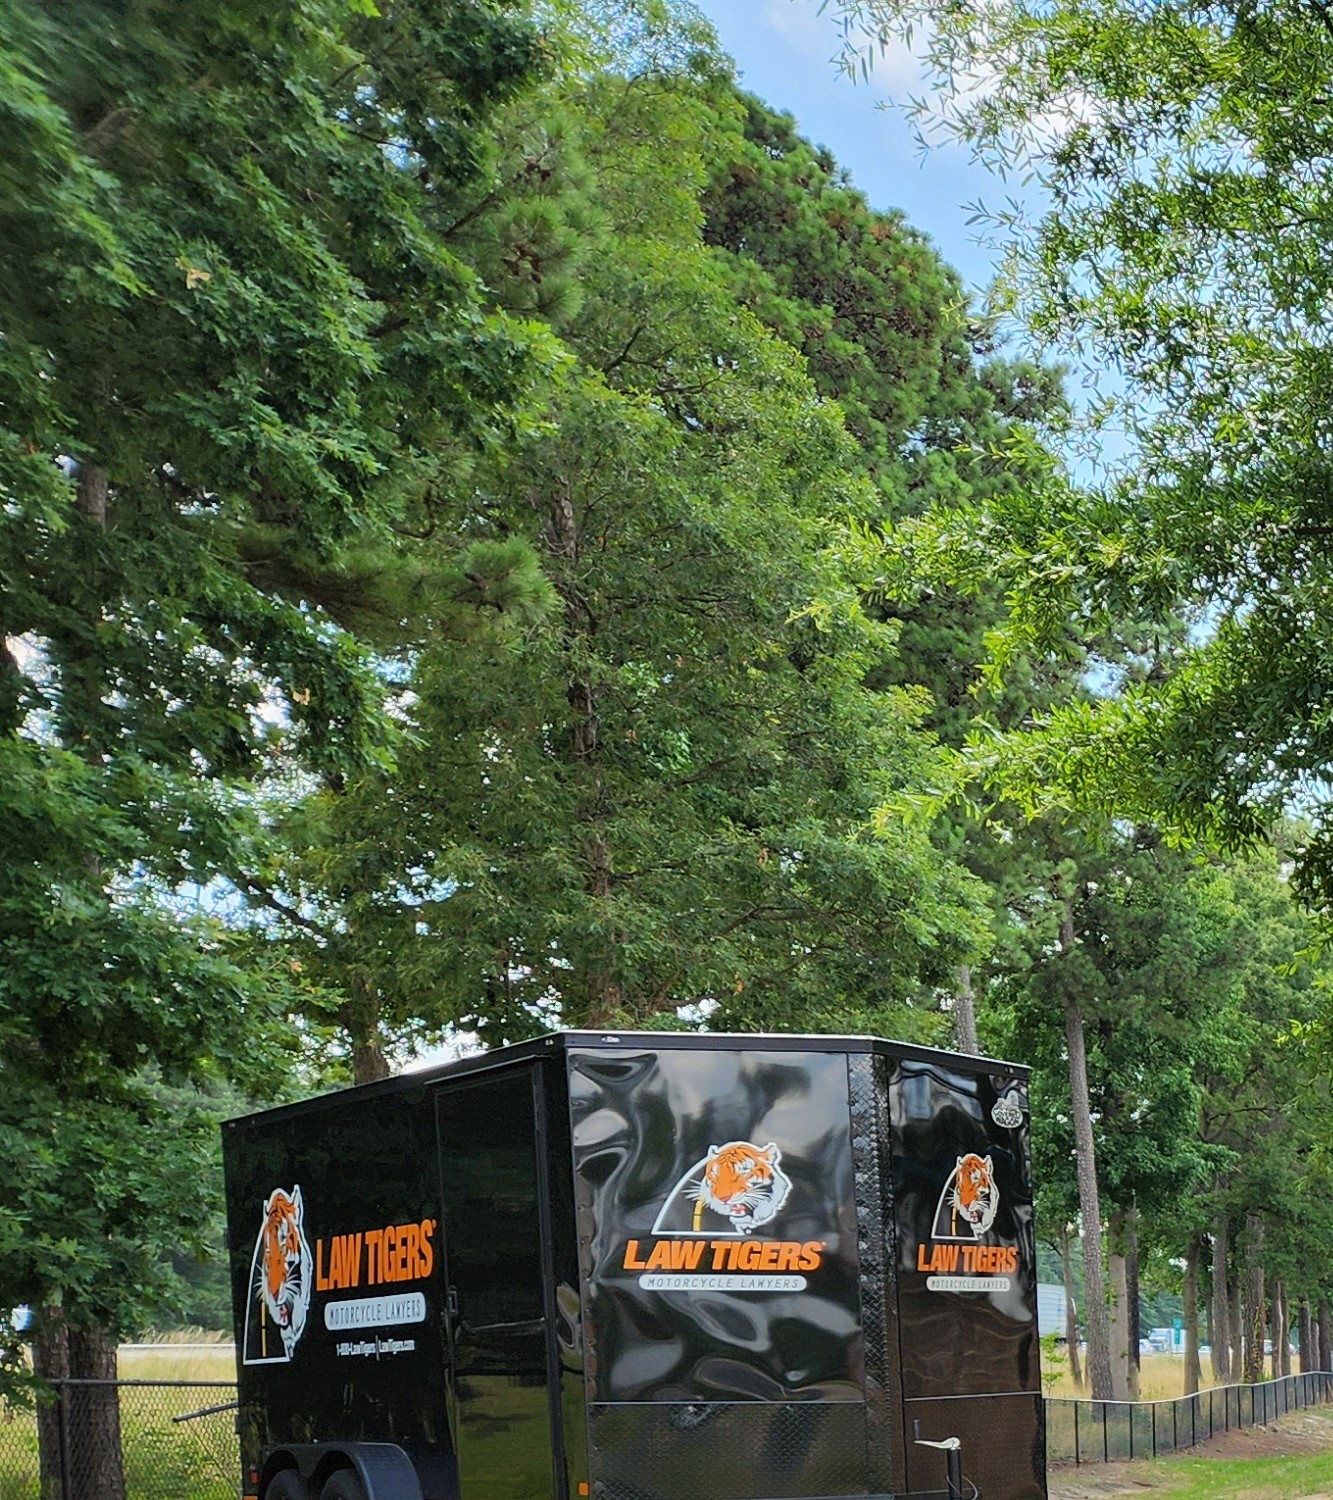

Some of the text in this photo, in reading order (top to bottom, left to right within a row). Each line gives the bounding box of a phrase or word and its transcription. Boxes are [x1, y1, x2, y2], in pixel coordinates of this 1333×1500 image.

[316, 1218, 434, 1292] LAW TIGERS
[623, 1240, 823, 1271] LAW TIGERS
[917, 1243, 1017, 1273] LAW TIGERS
[647, 1278, 800, 1289] MOTORCYCLE LAWYERS
[931, 1279, 1008, 1290] MOTORCYCLE LAWYERS
[329, 1299, 421, 1326] MOTORCYCLE LAWYERS
